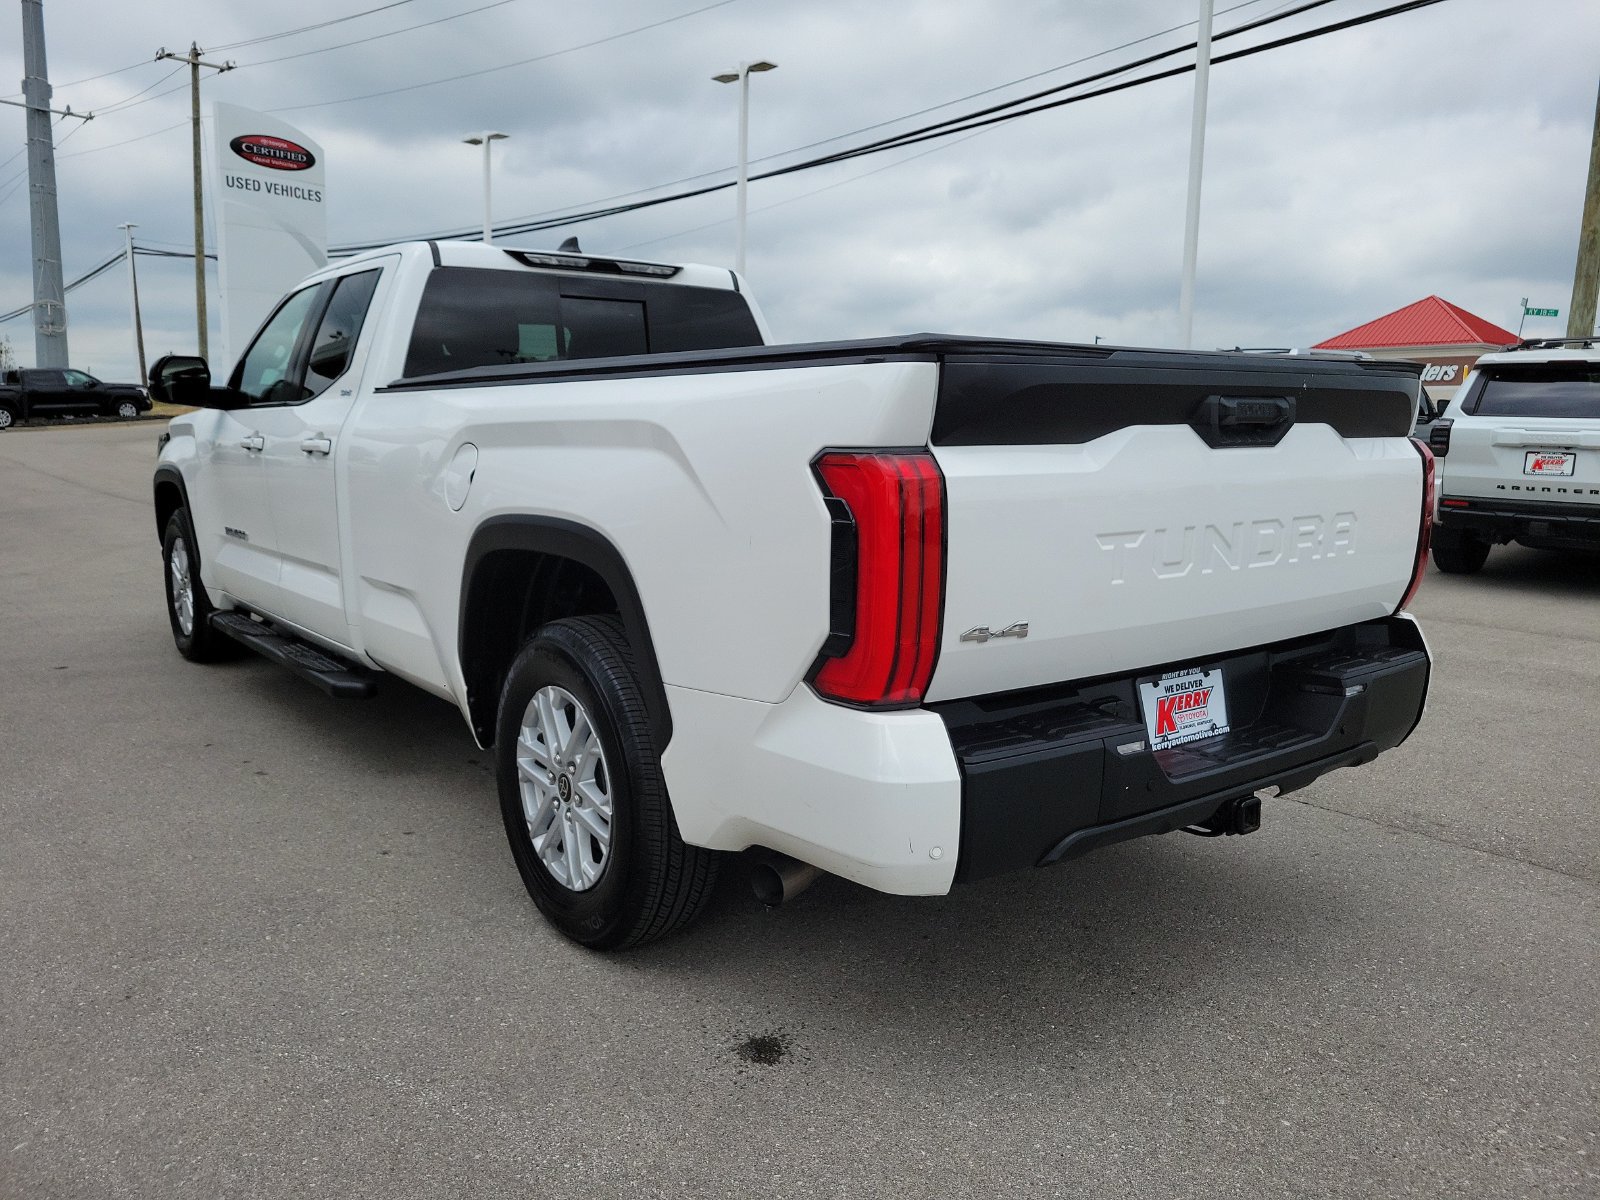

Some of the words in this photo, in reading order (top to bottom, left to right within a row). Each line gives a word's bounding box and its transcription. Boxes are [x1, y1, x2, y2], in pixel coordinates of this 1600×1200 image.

[241, 142, 307, 162] CERTIFIED
[226, 175, 261, 192] USED
[264, 181, 322, 203] VEHICLES
[1095, 511, 1358, 584] TUNDRA
[1162, 672, 1179, 680] RIGHT
[1164, 684, 1174, 694] WE
[1175, 679, 1203, 692] DELIVER
[1156, 688, 1211, 737] KERRY
[1185, 710, 1207, 721] TOYOTA
[1151, 726, 1230, 751] kerryautomotive.com
